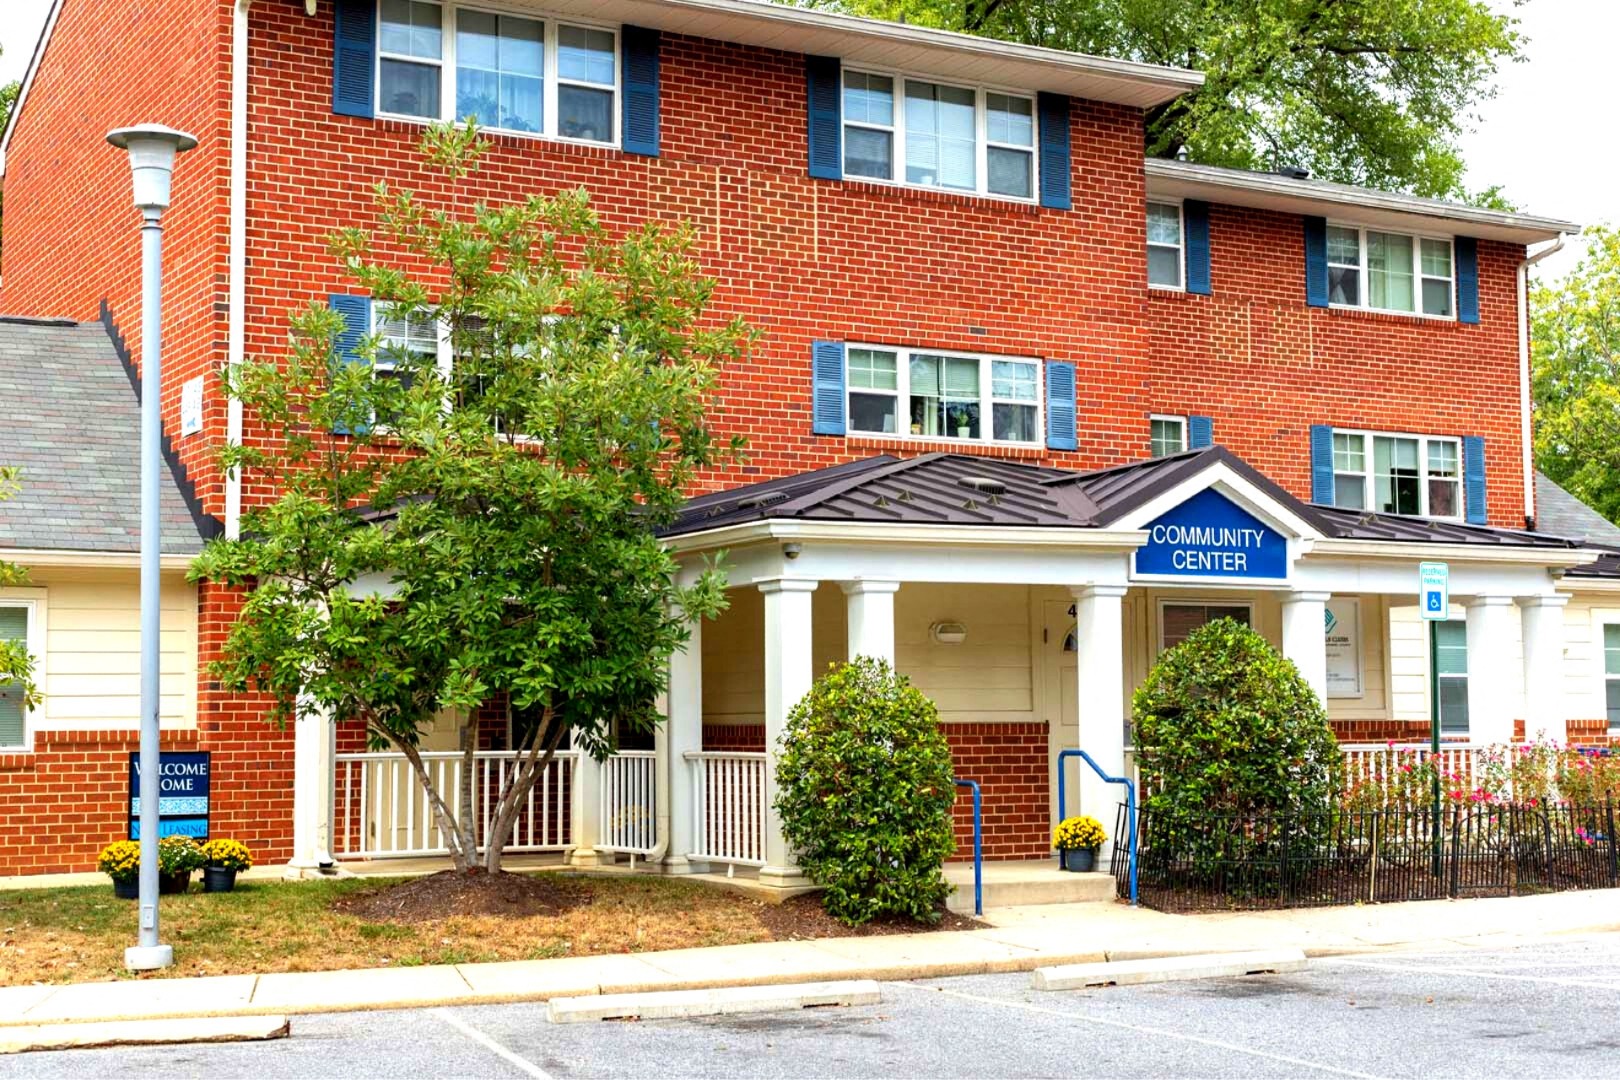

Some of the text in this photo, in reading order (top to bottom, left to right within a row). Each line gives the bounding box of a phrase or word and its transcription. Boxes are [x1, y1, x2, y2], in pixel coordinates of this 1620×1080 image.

[1152, 525, 1264, 548] COMMUNITY
[1173, 550, 1247, 571] CENTER
[1068, 604, 1077, 618] 4
[134, 762, 207, 776] LCOME
[160, 778, 193, 791] OME
[163, 823, 206, 835] LEASING
